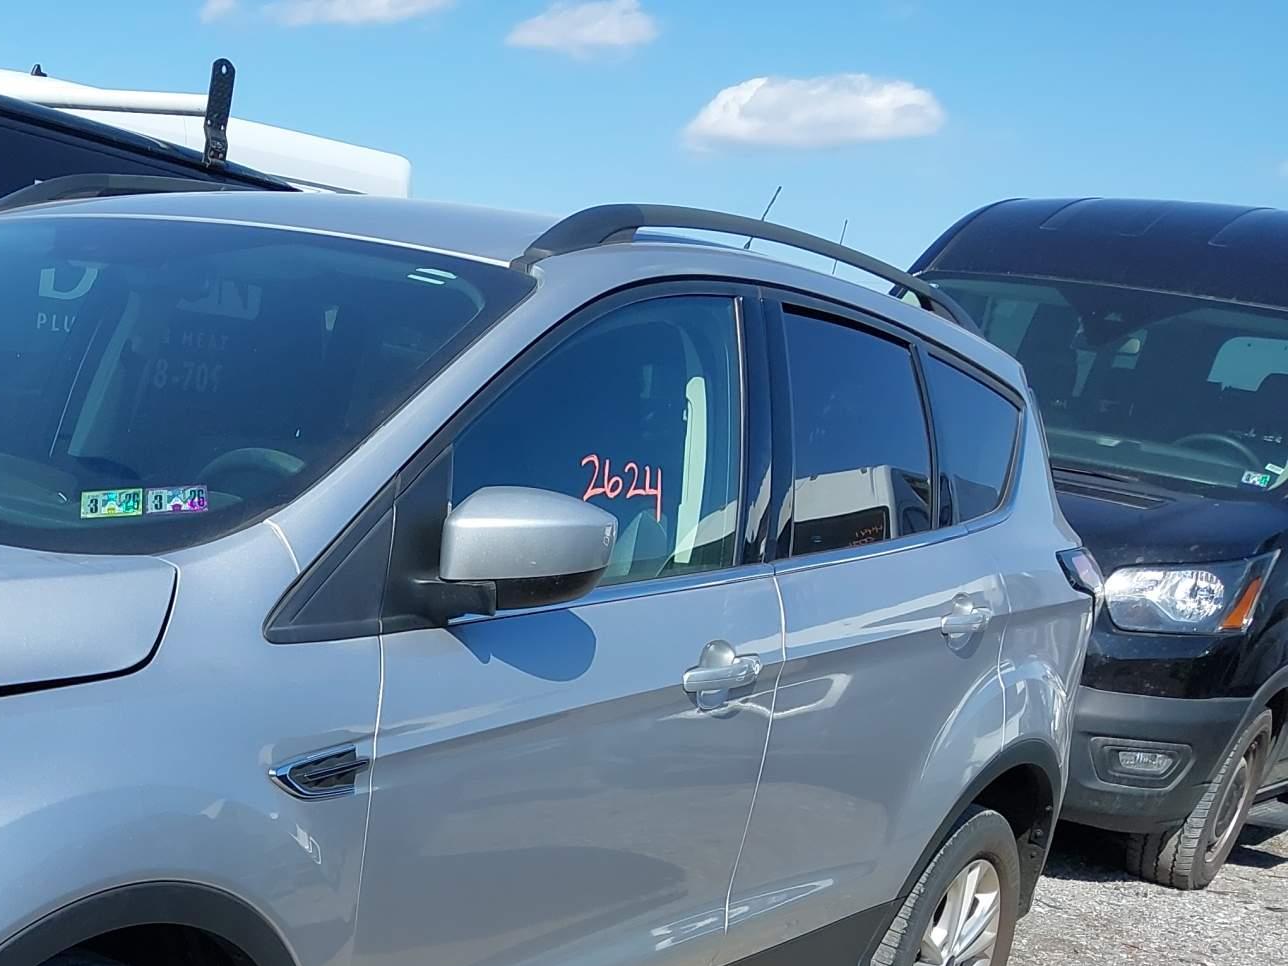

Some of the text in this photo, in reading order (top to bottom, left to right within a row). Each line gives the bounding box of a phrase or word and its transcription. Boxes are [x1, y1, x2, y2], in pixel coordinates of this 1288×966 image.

[581, 454, 662, 523] 2624
[88, 498, 99, 514] 3
[154, 489, 205, 510] 3 26
